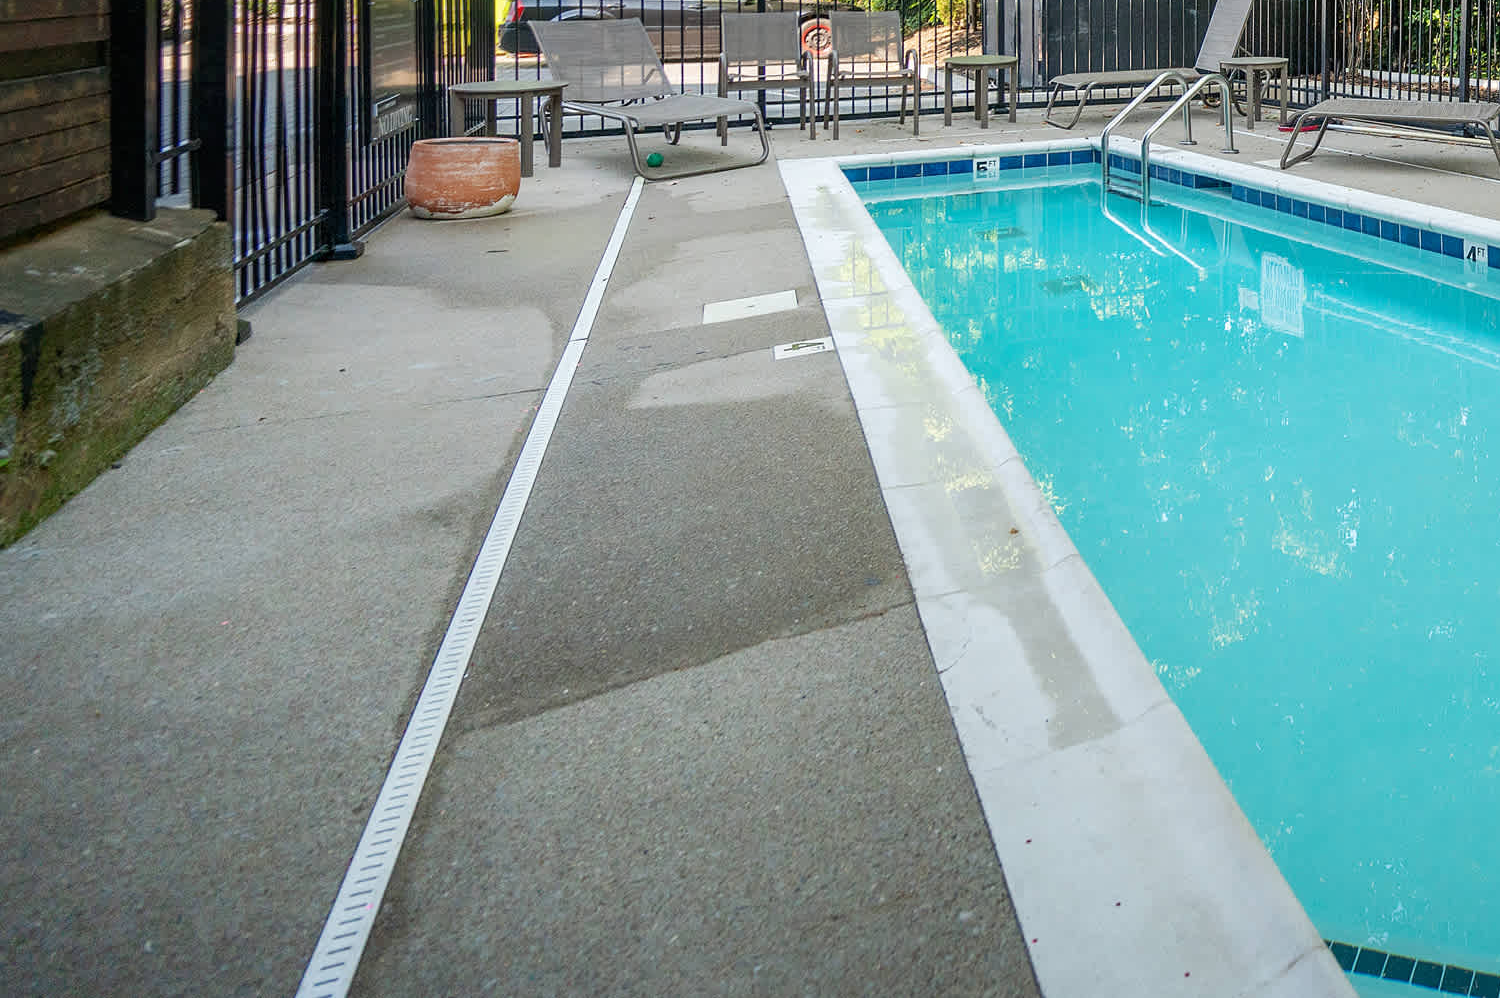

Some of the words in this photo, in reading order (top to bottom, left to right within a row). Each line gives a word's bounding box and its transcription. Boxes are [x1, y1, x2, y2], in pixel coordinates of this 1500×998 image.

[976, 161, 988, 171] 5
[1466, 246, 1476, 262] 4
[1477, 247, 1485, 258] FT
